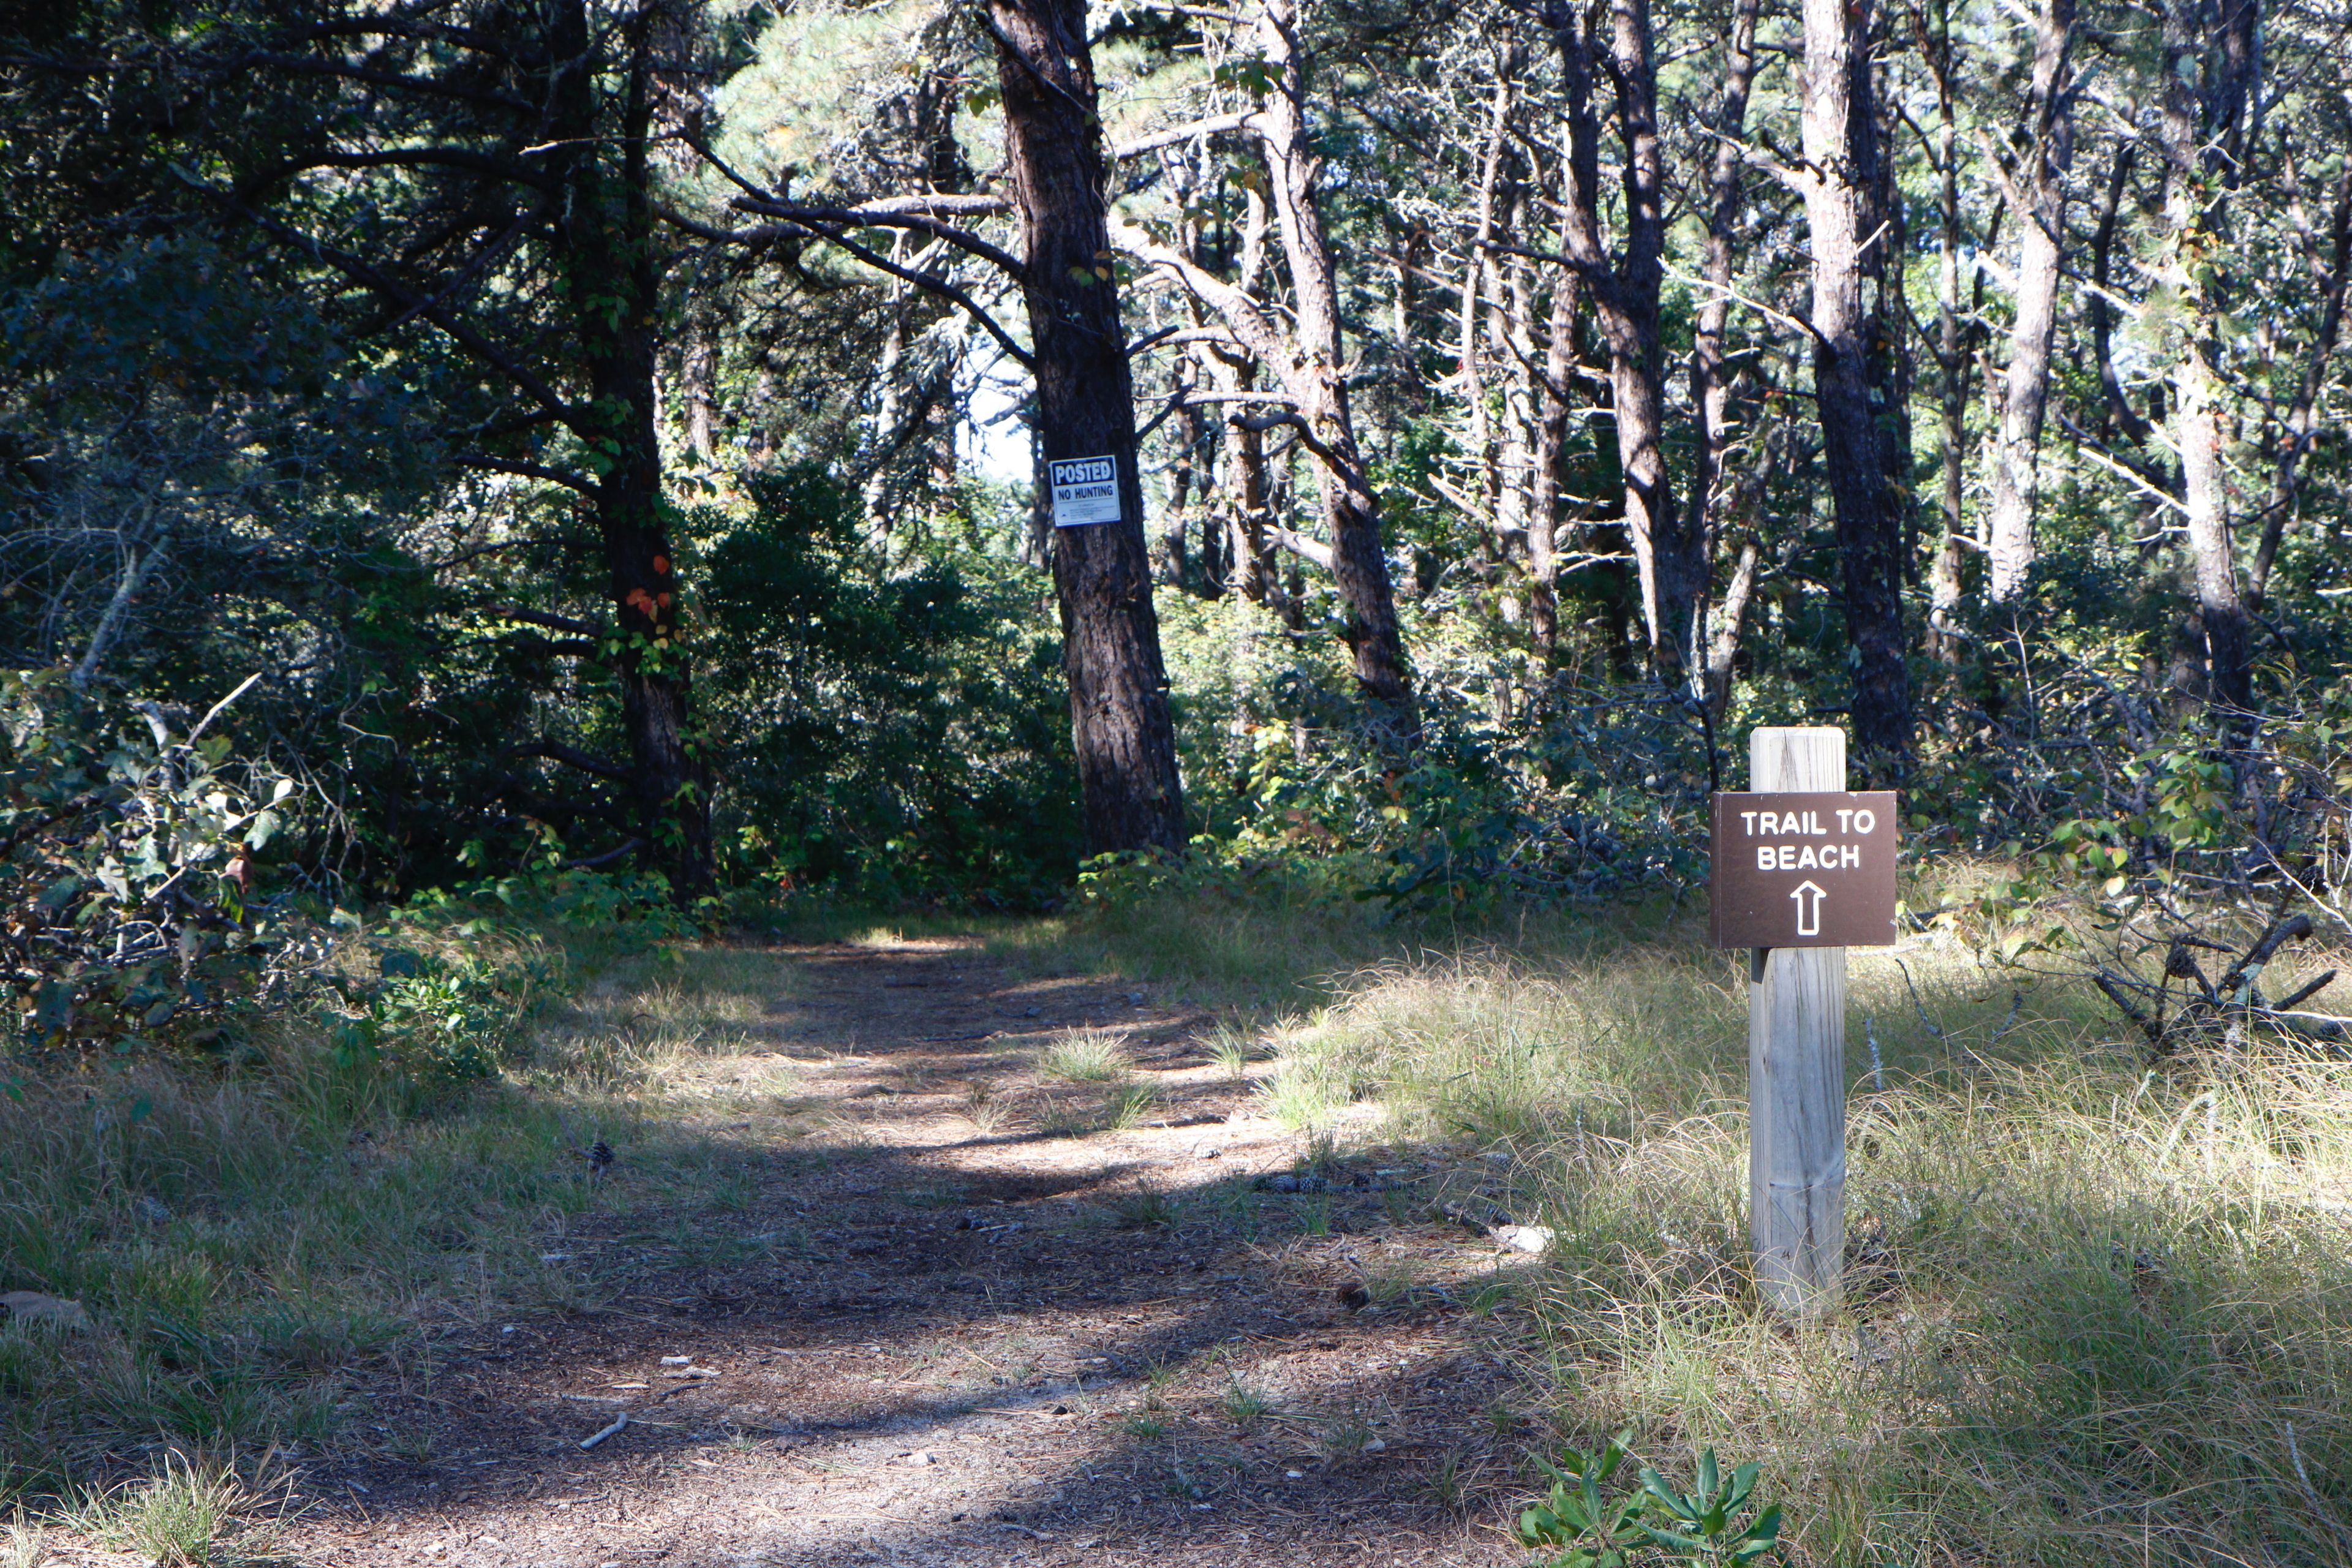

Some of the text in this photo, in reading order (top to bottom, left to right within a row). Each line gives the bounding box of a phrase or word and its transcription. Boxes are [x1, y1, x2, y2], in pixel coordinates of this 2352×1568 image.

[1055, 461, 1111, 484] POSTED
[1058, 485, 1113, 500] NO HUNTING
[1740, 809, 1875, 836] TRAIL TO
[1757, 845, 1860, 870] BEACH
